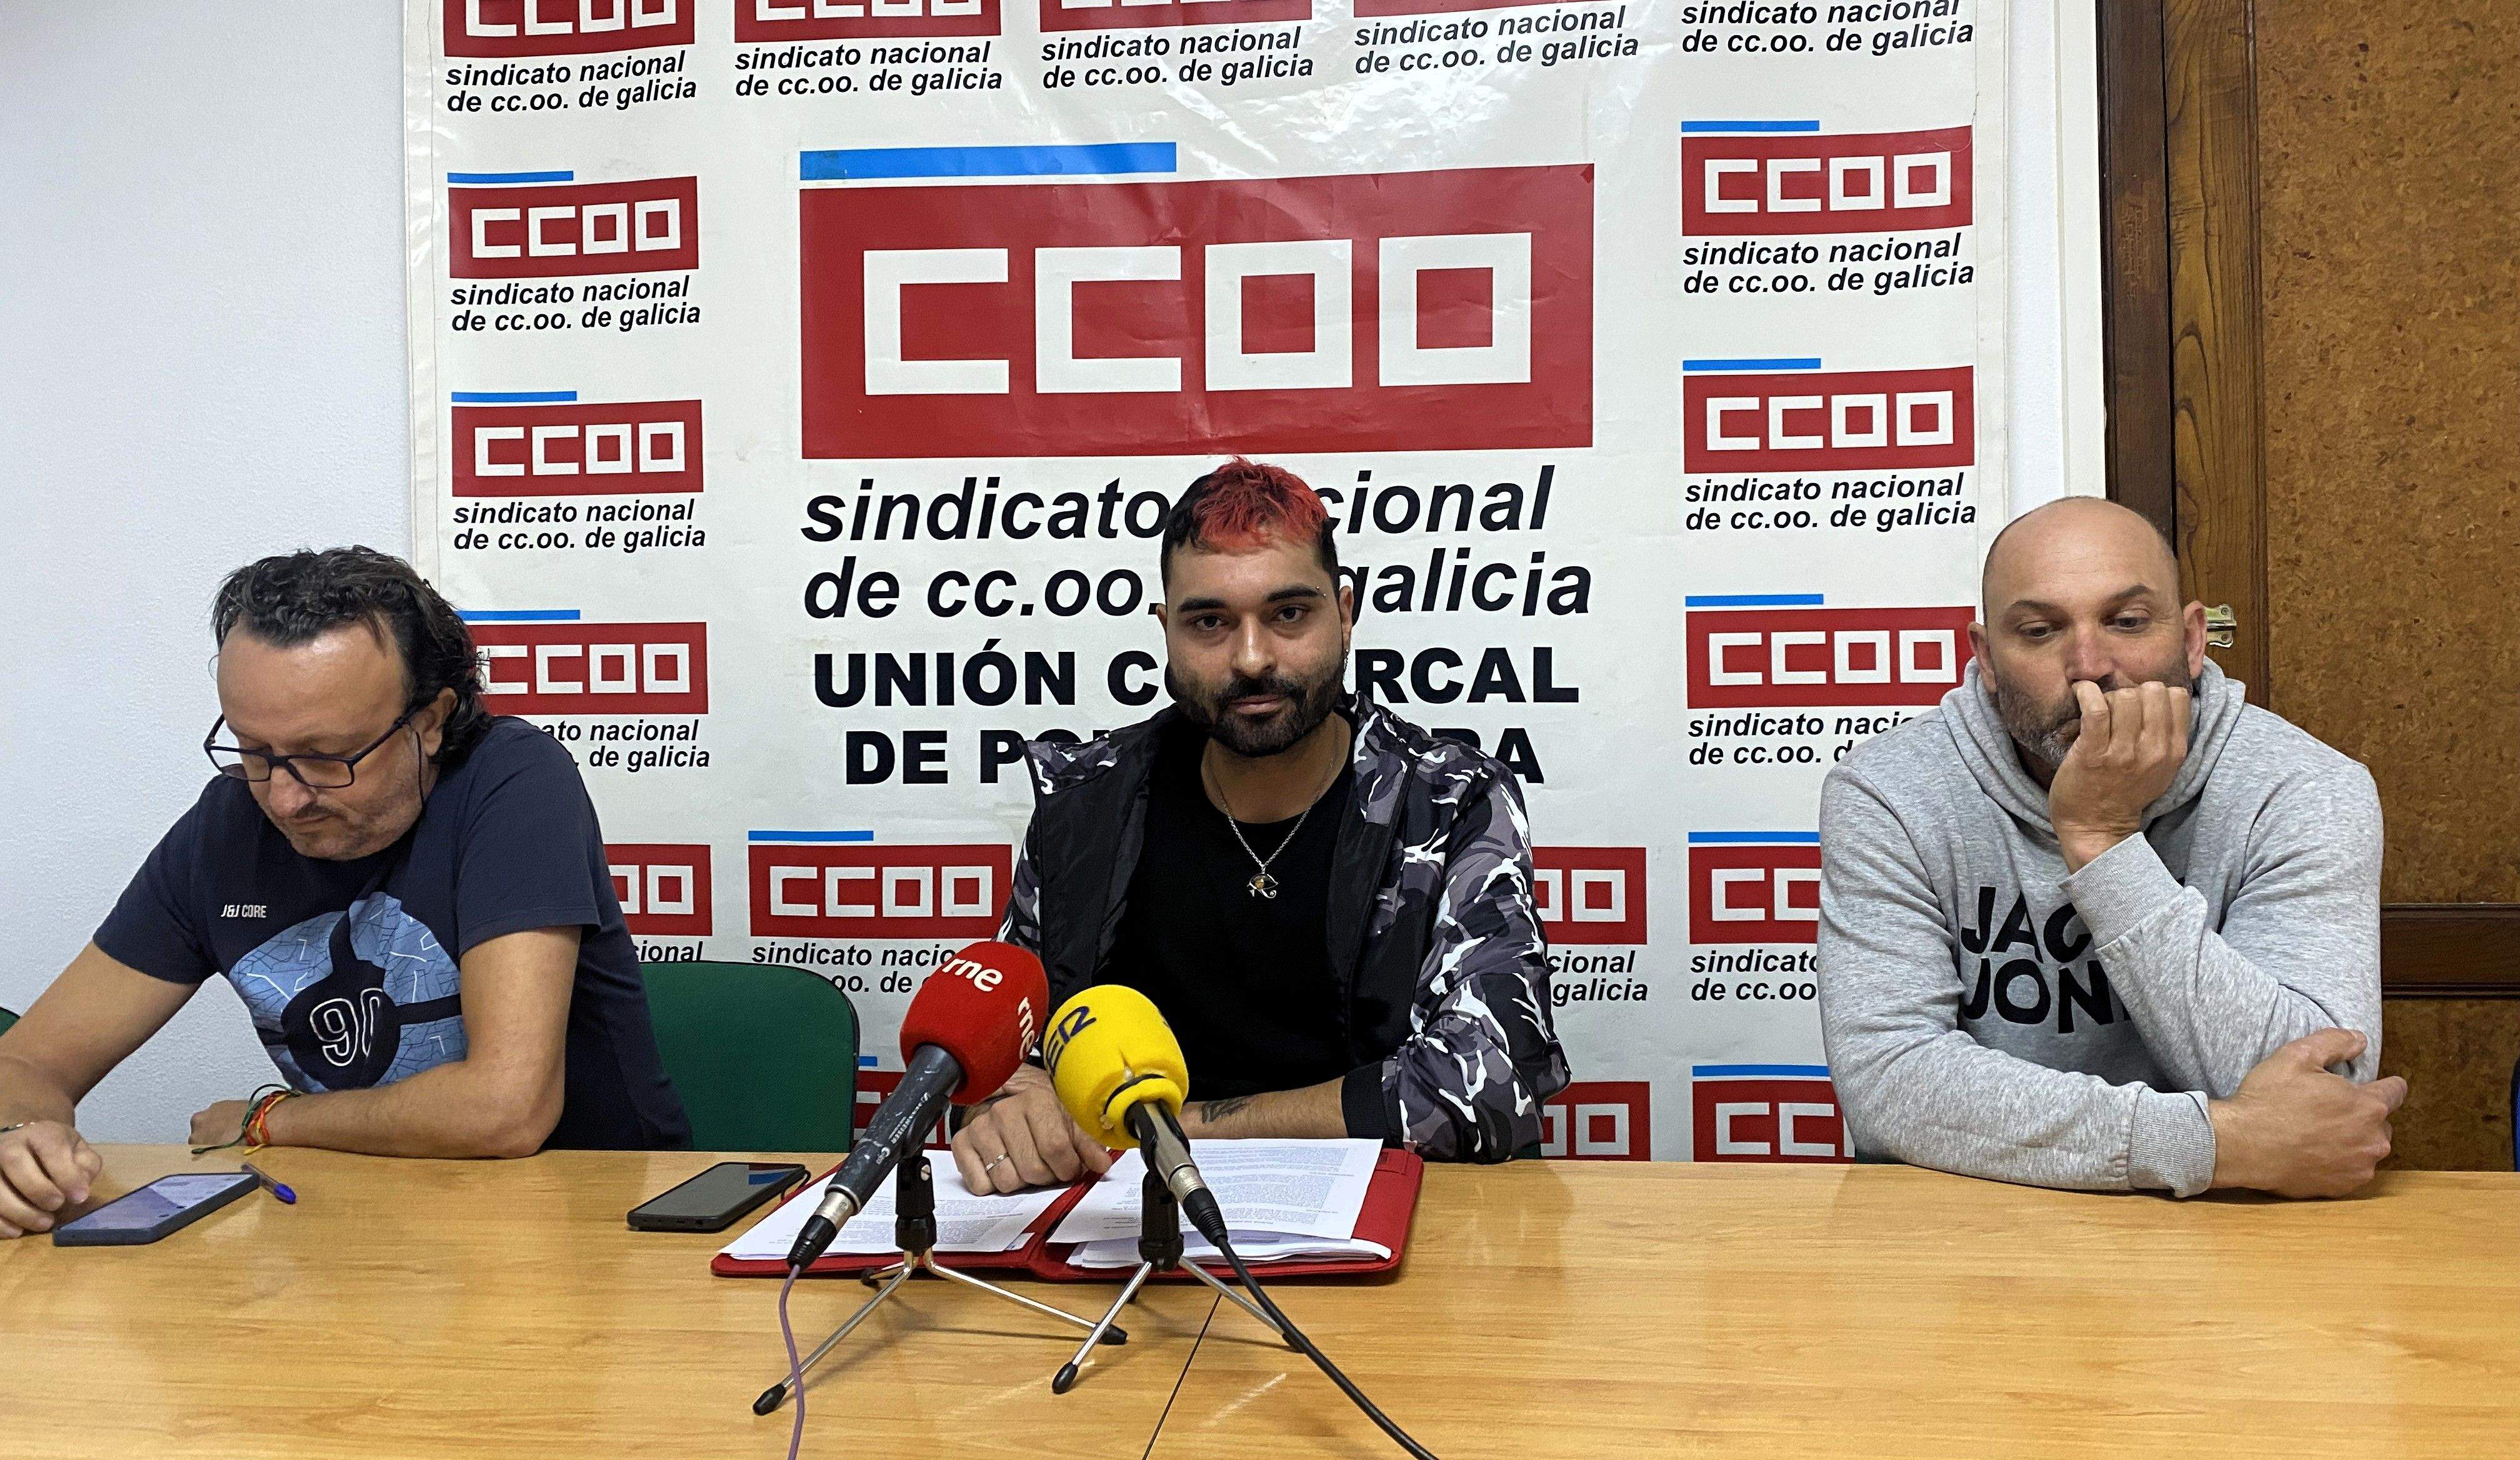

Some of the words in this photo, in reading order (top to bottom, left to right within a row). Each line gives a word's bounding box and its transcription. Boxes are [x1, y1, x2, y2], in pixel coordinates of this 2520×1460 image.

[1354, 18, 1488, 46] sindicato
[1499, 4, 1626, 38] nacional
[1682, 0, 1817, 24] sindicato
[1828, 0, 1959, 23] nacional
[735, 44, 861, 69] sindicato
[871, 41, 991, 64] nacional
[1041, 34, 1169, 61] sindicato
[1180, 26, 1301, 55] nacional
[1356, 51, 1389, 73] de
[1400, 50, 1484, 71] cc.oo.
[1498, 41, 1531, 63] de
[1541, 34, 1638, 66] galicia
[1682, 29, 1717, 52] de
[1728, 35, 1813, 52] cc.oo.
[1826, 28, 1861, 51] de
[1872, 21, 1972, 56] galicia
[446, 62, 570, 86] sindicato
[580, 50, 685, 82] nacional
[736, 74, 768, 96] de
[778, 76, 858, 95] cc.oo.
[869, 69, 902, 91] de
[911, 68, 1001, 96] galicia
[1044, 66, 1075, 88] de
[1085, 67, 1167, 86] cc.oo.
[1179, 59, 1211, 82] de
[1221, 54, 1312, 86] galicia
[448, 91, 481, 112] de
[491, 94, 568, 112] cc.oo.
[579, 86, 608, 108] de
[616, 77, 696, 110] galicia
[1705, 151, 1951, 212] CCOO
[472, 199, 681, 258] CCOO
[1683, 241, 1818, 265] sindicato
[1829, 232, 1961, 262] nacional
[451, 282, 574, 304] sindicato
[582, 275, 689, 306] nacional
[1684, 271, 1718, 293] de
[1729, 275, 1814, 292] cc.oo.
[1828, 268, 1863, 291] de
[1874, 261, 1973, 295] galicia
[452, 310, 486, 331] de
[496, 313, 571, 331] cc.oo.
[582, 306, 611, 328] de
[619, 302, 700, 332] galicia
[864, 232, 1532, 394] CCOO
[1707, 391, 1953, 451] CCOO
[475, 422, 685, 476] CCOO
[801, 477, 1170, 542] sindicato
[1315, 465, 1555, 535] ional
[1685, 478, 1821, 502] sindicato
[1832, 472, 1964, 499] nacional
[453, 502, 577, 523] sindicato
[586, 499, 694, 521] nacional
[1686, 508, 1720, 530] de
[1731, 511, 1817, 529] cc.oo.
[1831, 504, 1866, 527] de
[1877, 501, 1976, 532] galicia
[454, 528, 488, 549] de
[499, 532, 574, 549] cc.oo.
[586, 526, 615, 548] de
[624, 525, 705, 553] galicia
[805, 556, 899, 618] de
[815, 639, 1075, 708] UNIÓN
[1709, 629, 1956, 685] CCOO
[590, 719, 699, 741] nacional
[1688, 713, 1823, 737] sindicato
[589, 746, 619, 766] de
[628, 746, 709, 772] galicia
[846, 731, 948, 784] DE
[1689, 742, 1723, 765] de
[1734, 746, 1821, 764] cc.oo.
[769, 866, 992, 916] CCOO
[1712, 868, 1822, 921] CC
[221, 904, 240, 918] J&J
[242, 904, 267, 918] CORE
[1961, 886, 2092, 964] JAC
[634, 940, 703, 962] ional
[751, 942, 871, 966] sindicato
[881, 944, 955, 966] nacio
[1548, 950, 1636, 974] cional
[881, 971, 912, 993] de
[942, 958, 1003, 992] rne
[1692, 978, 1726, 1001] de
[1736, 983, 1816, 1000] cc.oo
[1552, 978, 1648, 1007] galicia
[1962, 958, 2132, 1033] JON
[1716, 1102, 1854, 1157] CC
